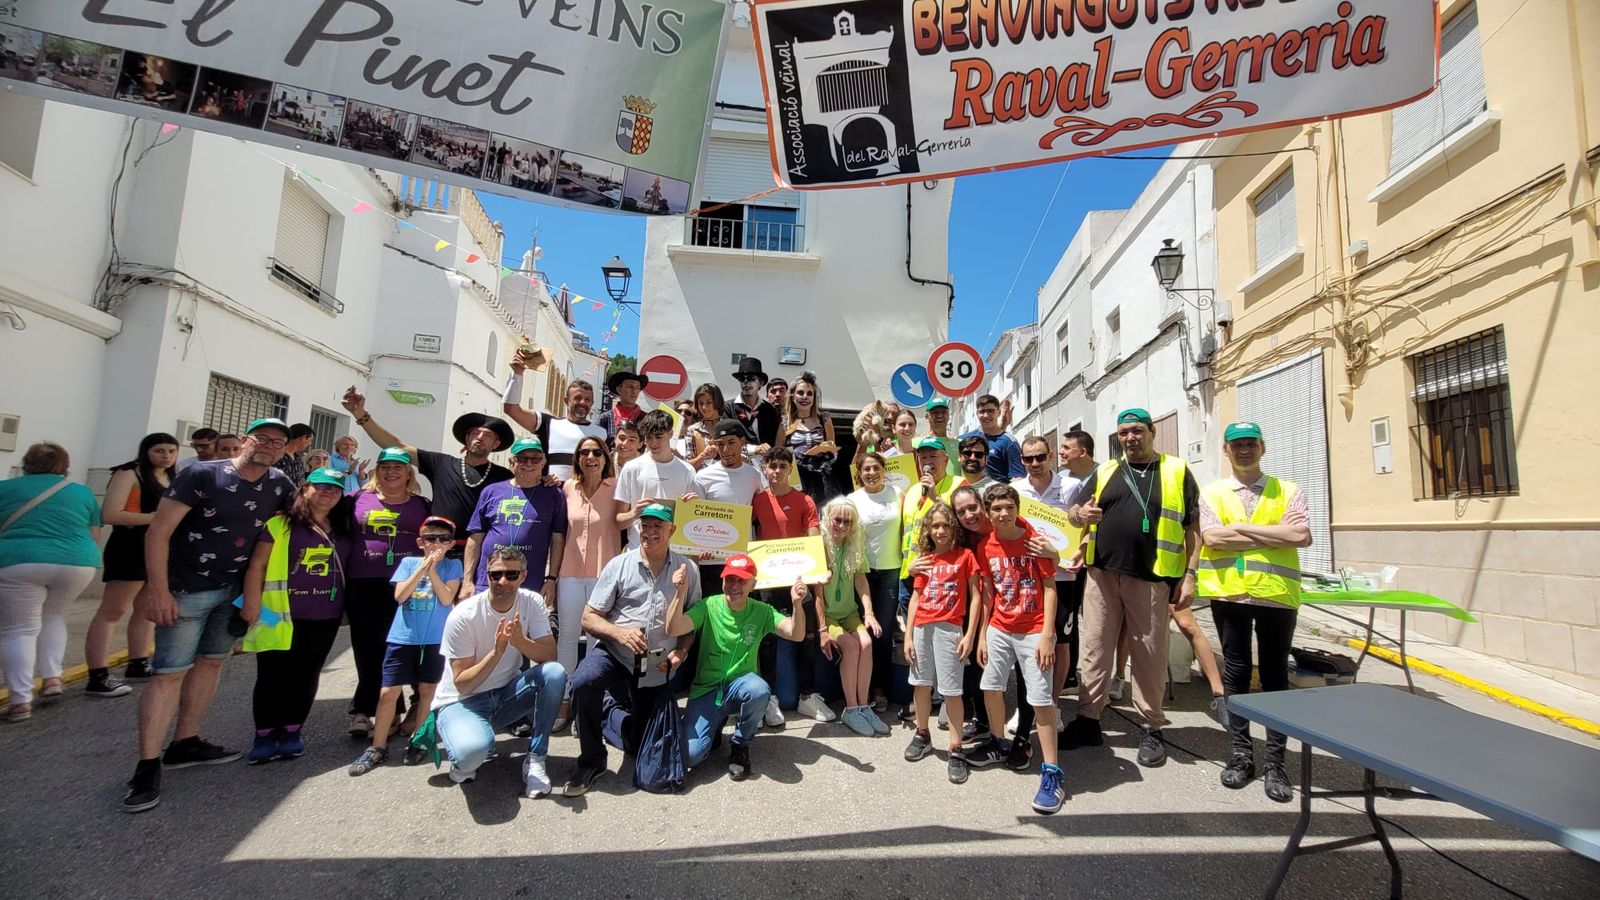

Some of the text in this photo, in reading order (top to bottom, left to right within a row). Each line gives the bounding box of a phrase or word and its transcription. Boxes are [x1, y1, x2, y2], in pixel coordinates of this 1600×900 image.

[284, 0, 566, 115] Pinet
[943, 1, 1387, 130] Raval-Gerreria
[779, 98, 808, 178] Associació
[846, 136, 972, 164] del Raval-Gerreria
[940, 360, 973, 378] 30
[694, 509, 733, 520] Carretons
[1027, 508, 1066, 528] Carretons
[766, 546, 806, 554] Carretons
